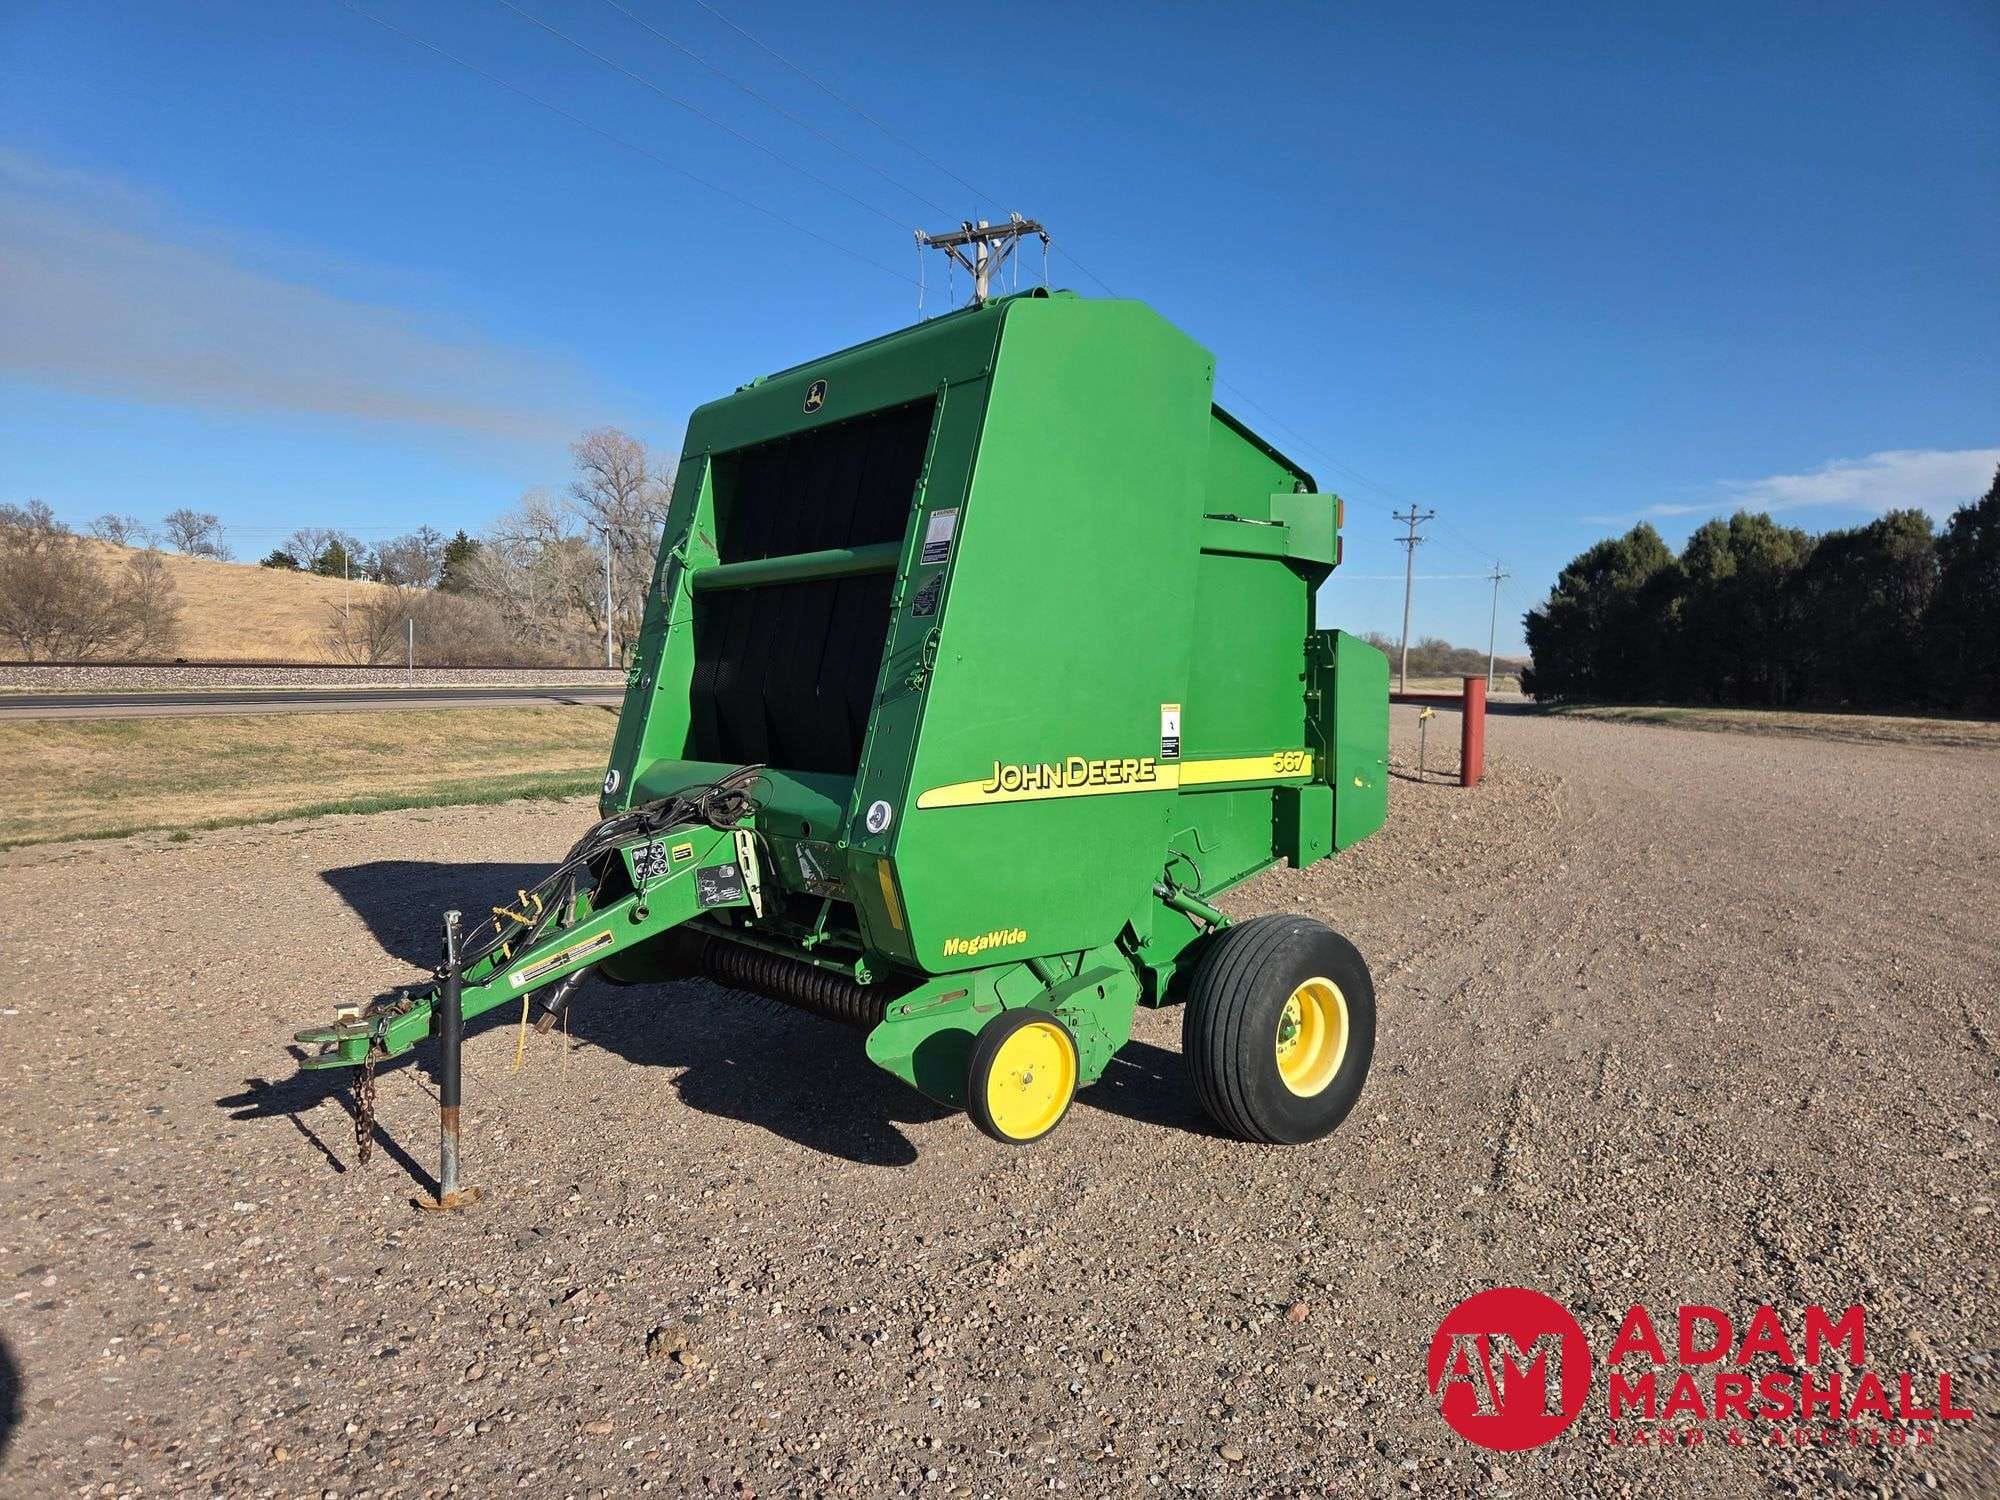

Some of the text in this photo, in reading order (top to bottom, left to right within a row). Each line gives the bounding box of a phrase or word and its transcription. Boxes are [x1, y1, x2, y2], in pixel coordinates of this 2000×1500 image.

[983, 756, 1157, 793] JOHN DEERE
[1273, 751, 1305, 773] 567
[943, 928, 1027, 957] MegaWide
